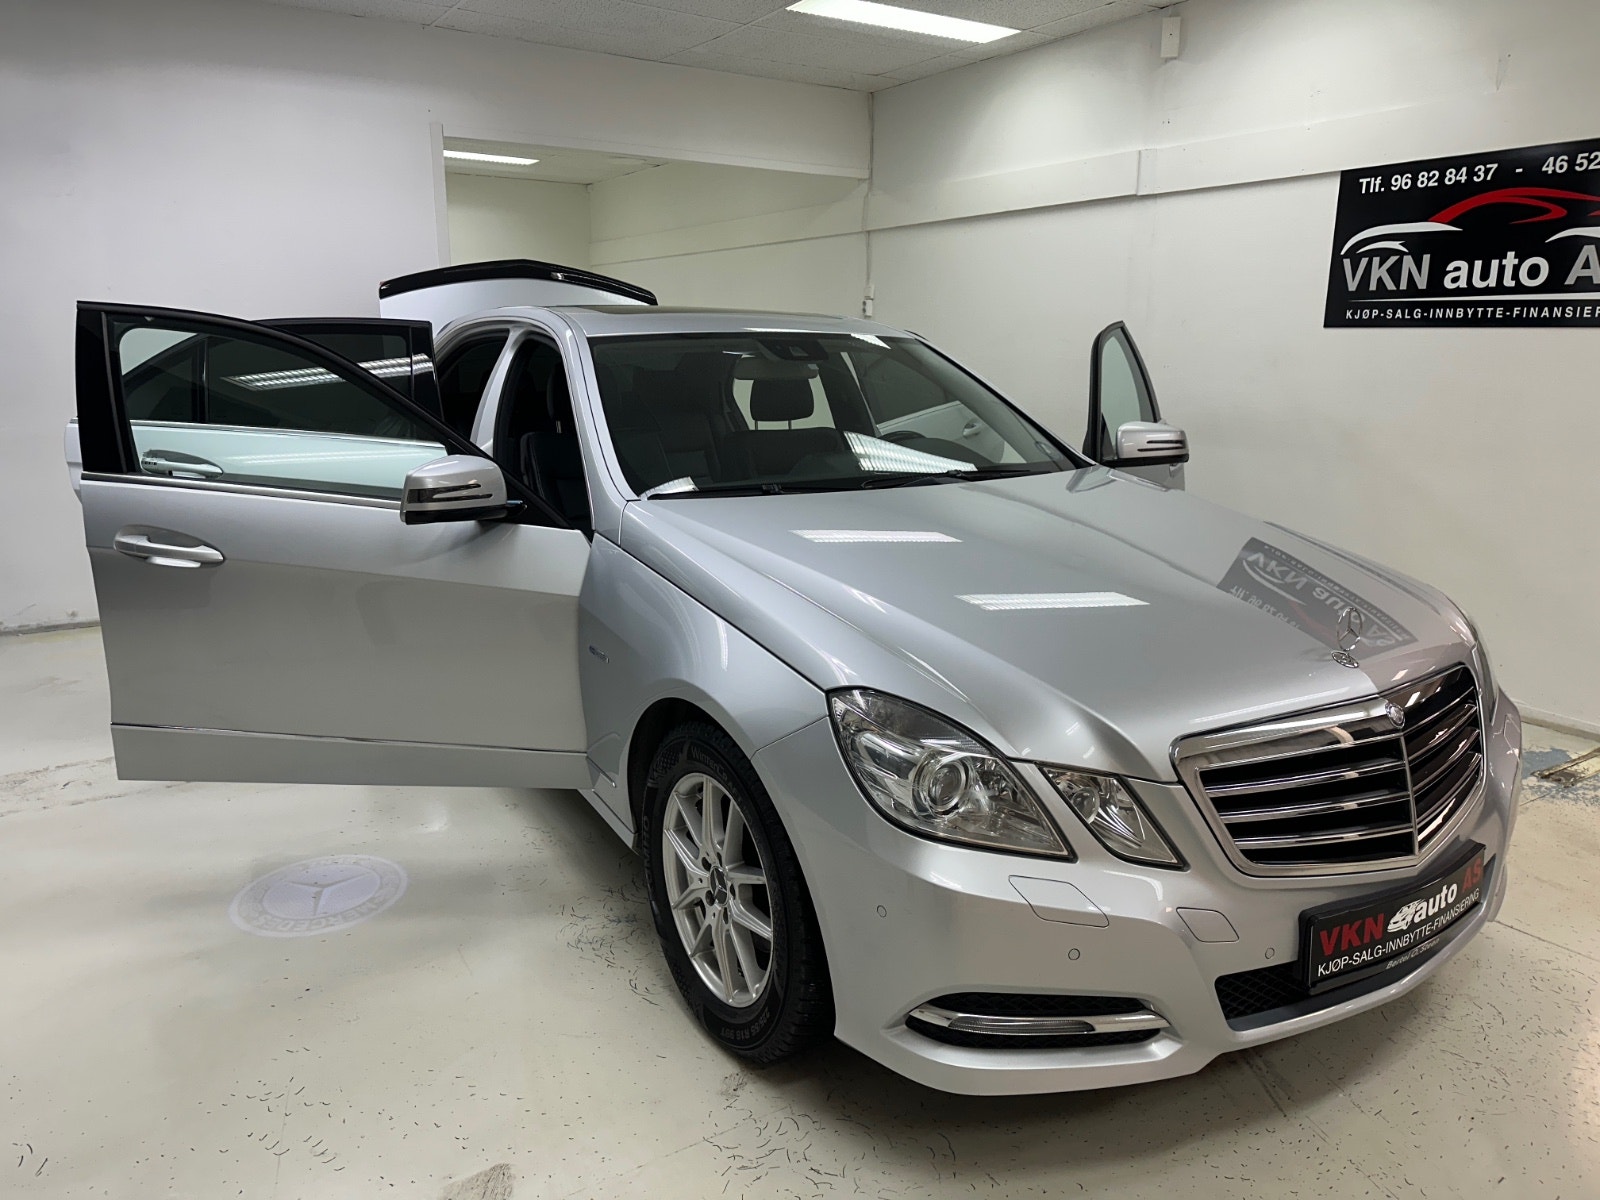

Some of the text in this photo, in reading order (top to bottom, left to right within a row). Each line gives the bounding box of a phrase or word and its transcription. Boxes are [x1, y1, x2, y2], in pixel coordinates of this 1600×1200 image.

[1359, 177, 1385, 194] Tlf.
[1391, 174, 1412, 191] 96
[1417, 170, 1439, 188] 82
[1444, 167, 1467, 185] 84
[1473, 163, 1498, 182] 37
[1541, 155, 1568, 174] 46
[1574, 151, 1600, 172] 52
[1343, 254, 1430, 291] VKN
[1443, 251, 1550, 289] auto
[1320, 858, 1482, 956] VKN auto AS
